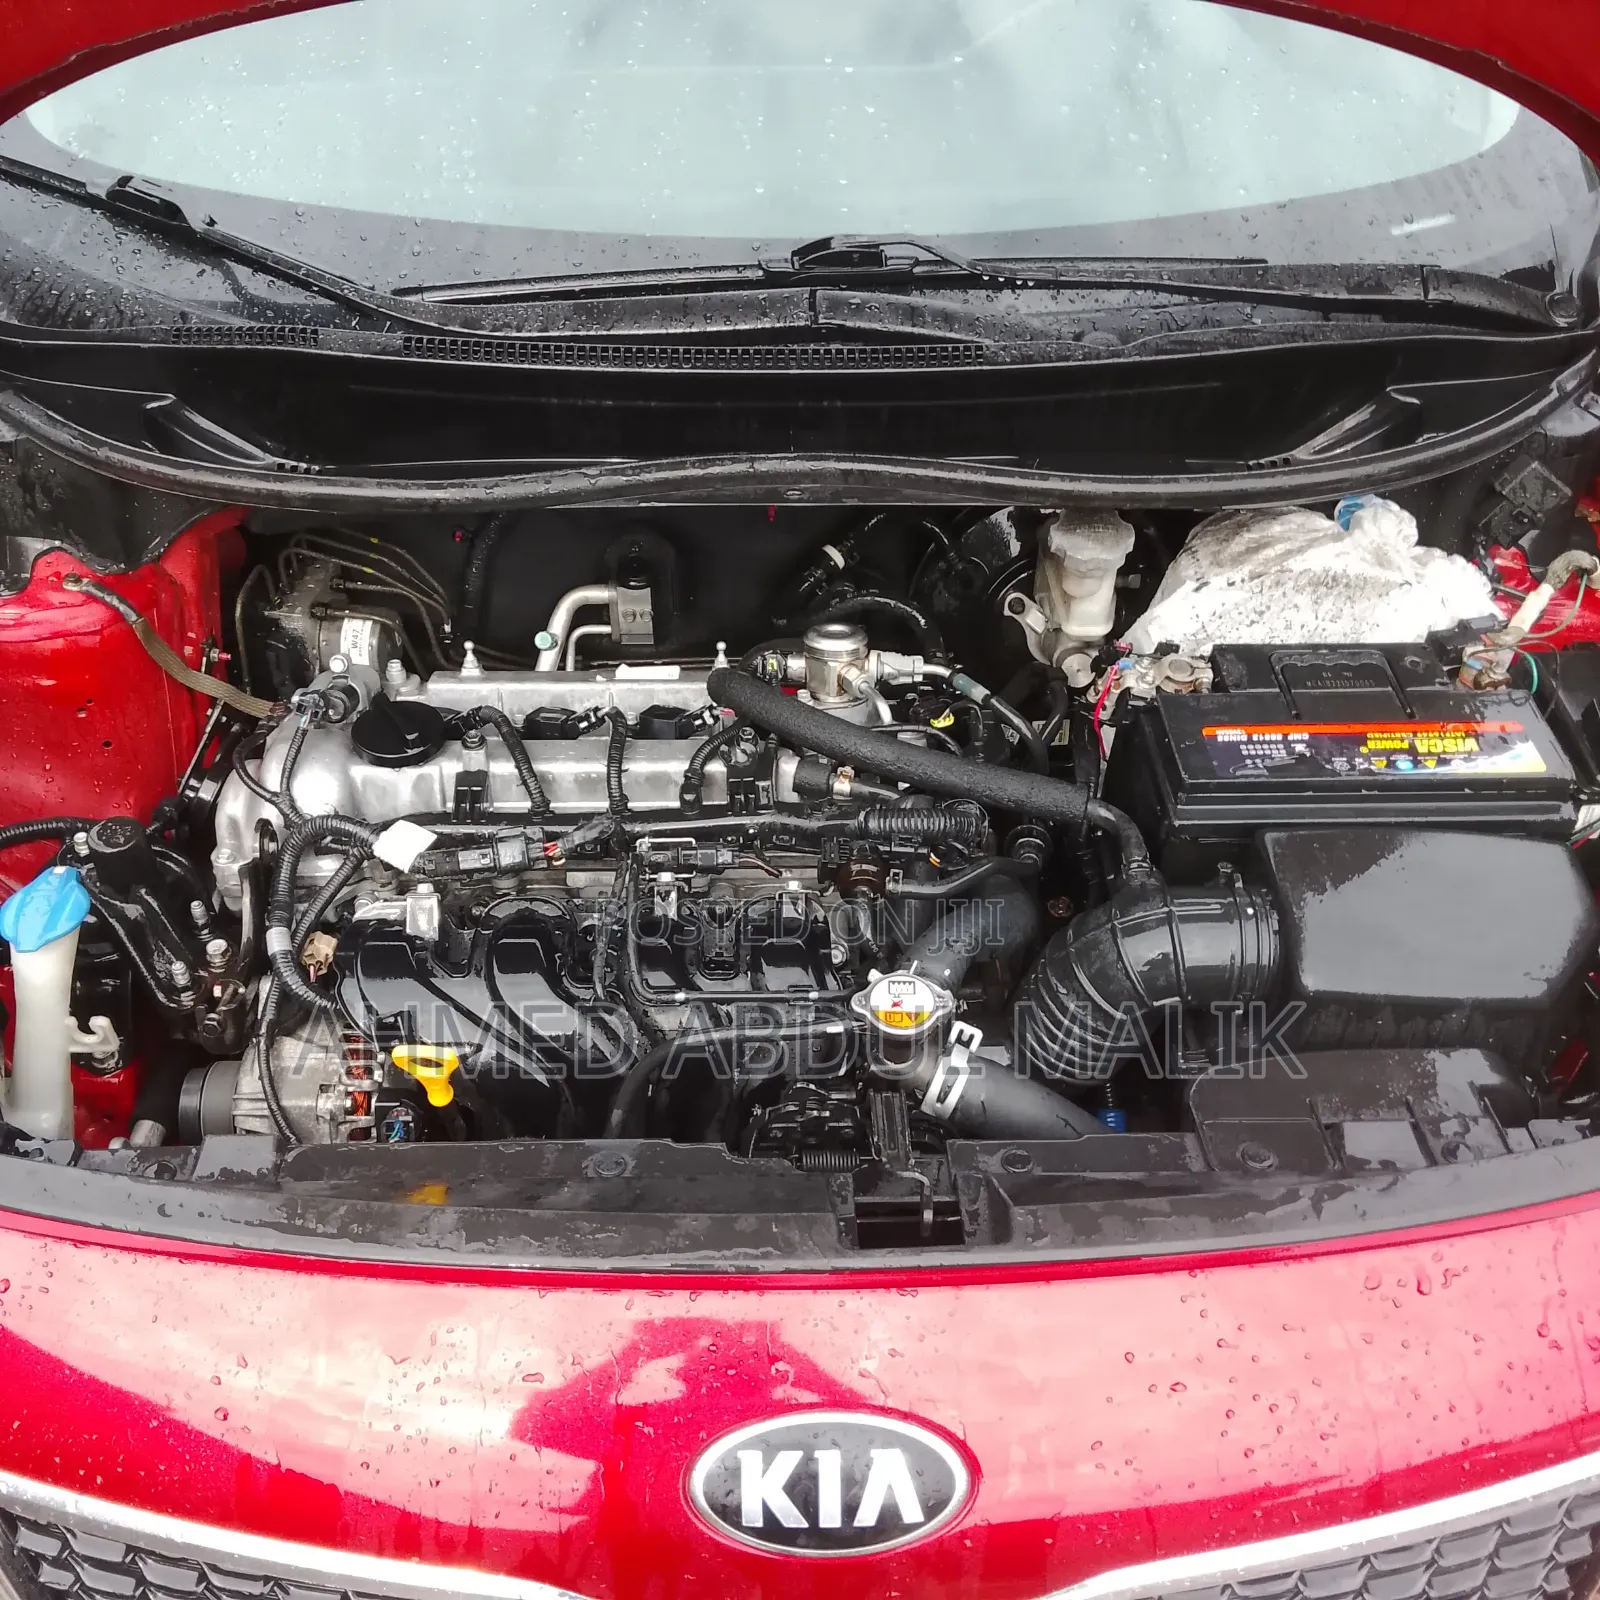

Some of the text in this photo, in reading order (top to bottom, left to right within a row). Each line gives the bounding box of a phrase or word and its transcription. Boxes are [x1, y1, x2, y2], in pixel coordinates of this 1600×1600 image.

[1367, 738, 1480, 753] VISCA POWER
[737, 1448, 925, 1528] KIA
